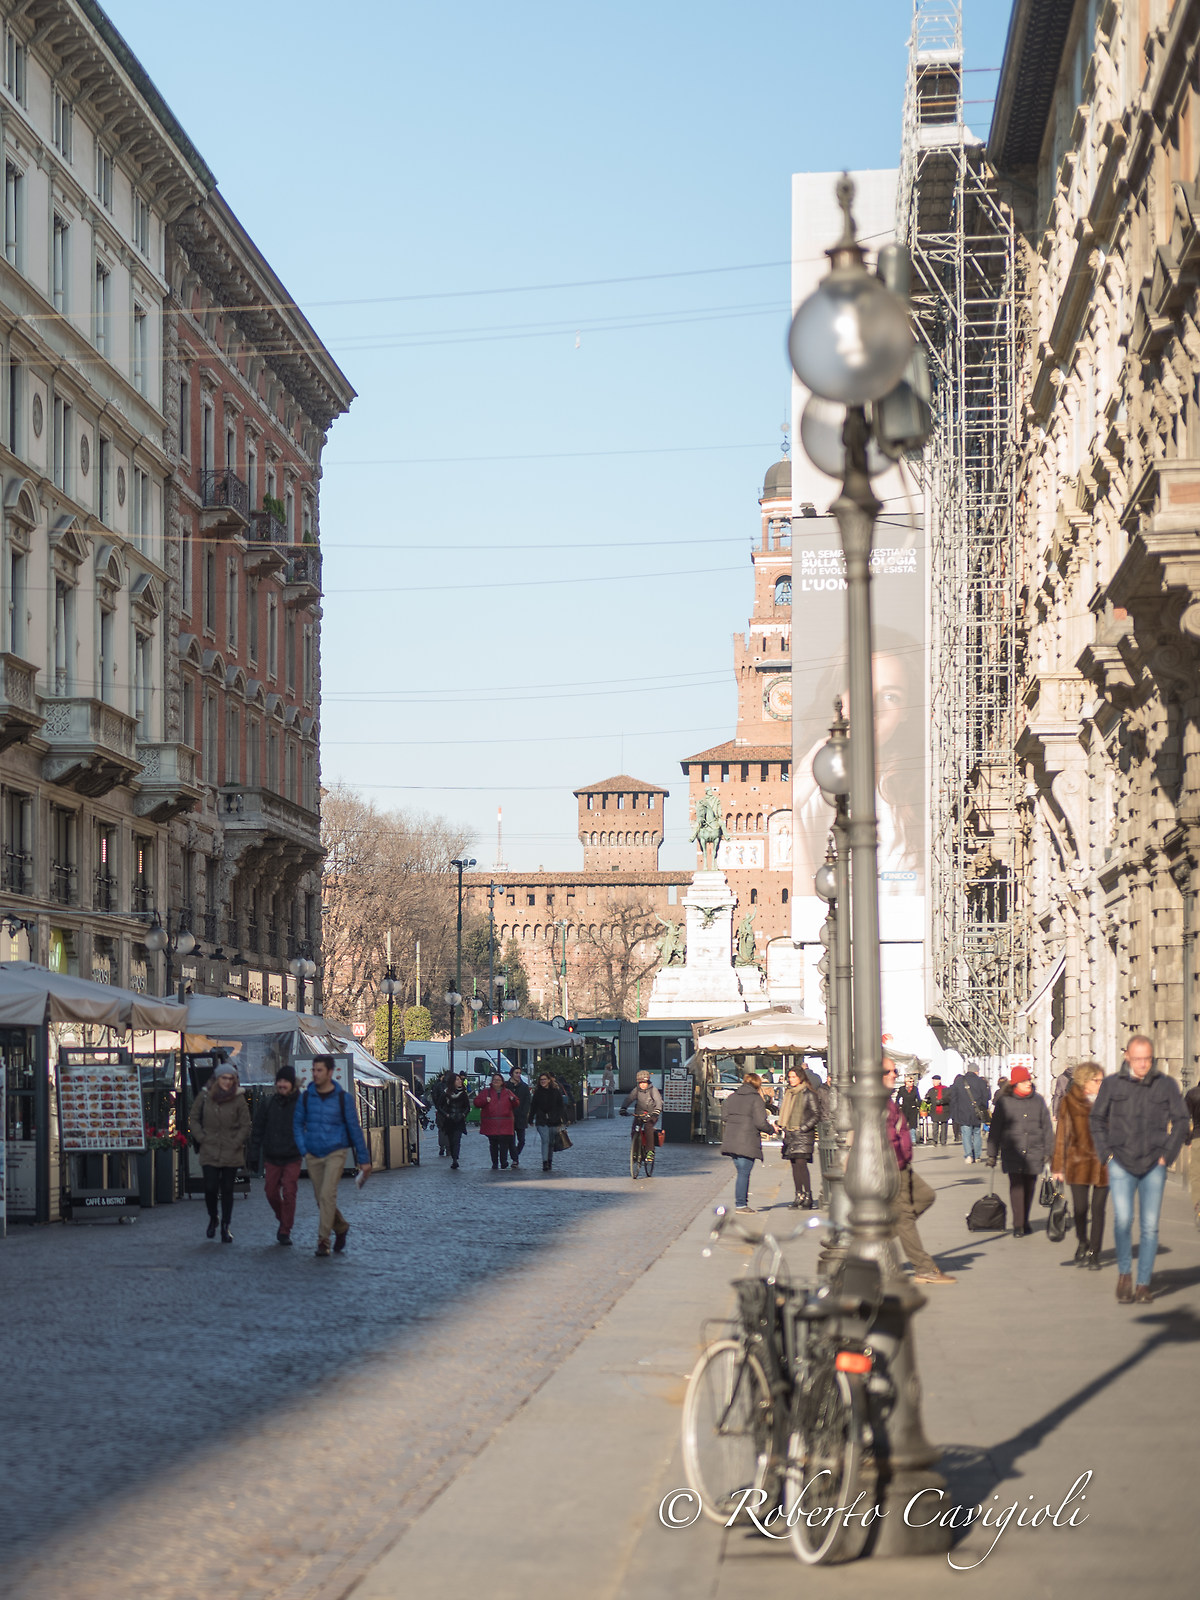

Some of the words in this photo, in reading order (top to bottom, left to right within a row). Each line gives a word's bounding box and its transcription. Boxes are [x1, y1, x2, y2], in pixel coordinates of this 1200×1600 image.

[802, 550, 816, 558] DA
[818, 549, 846, 558] SEMP
[802, 558, 839, 568] SULLA
[801, 578, 848, 592] L'UOM
